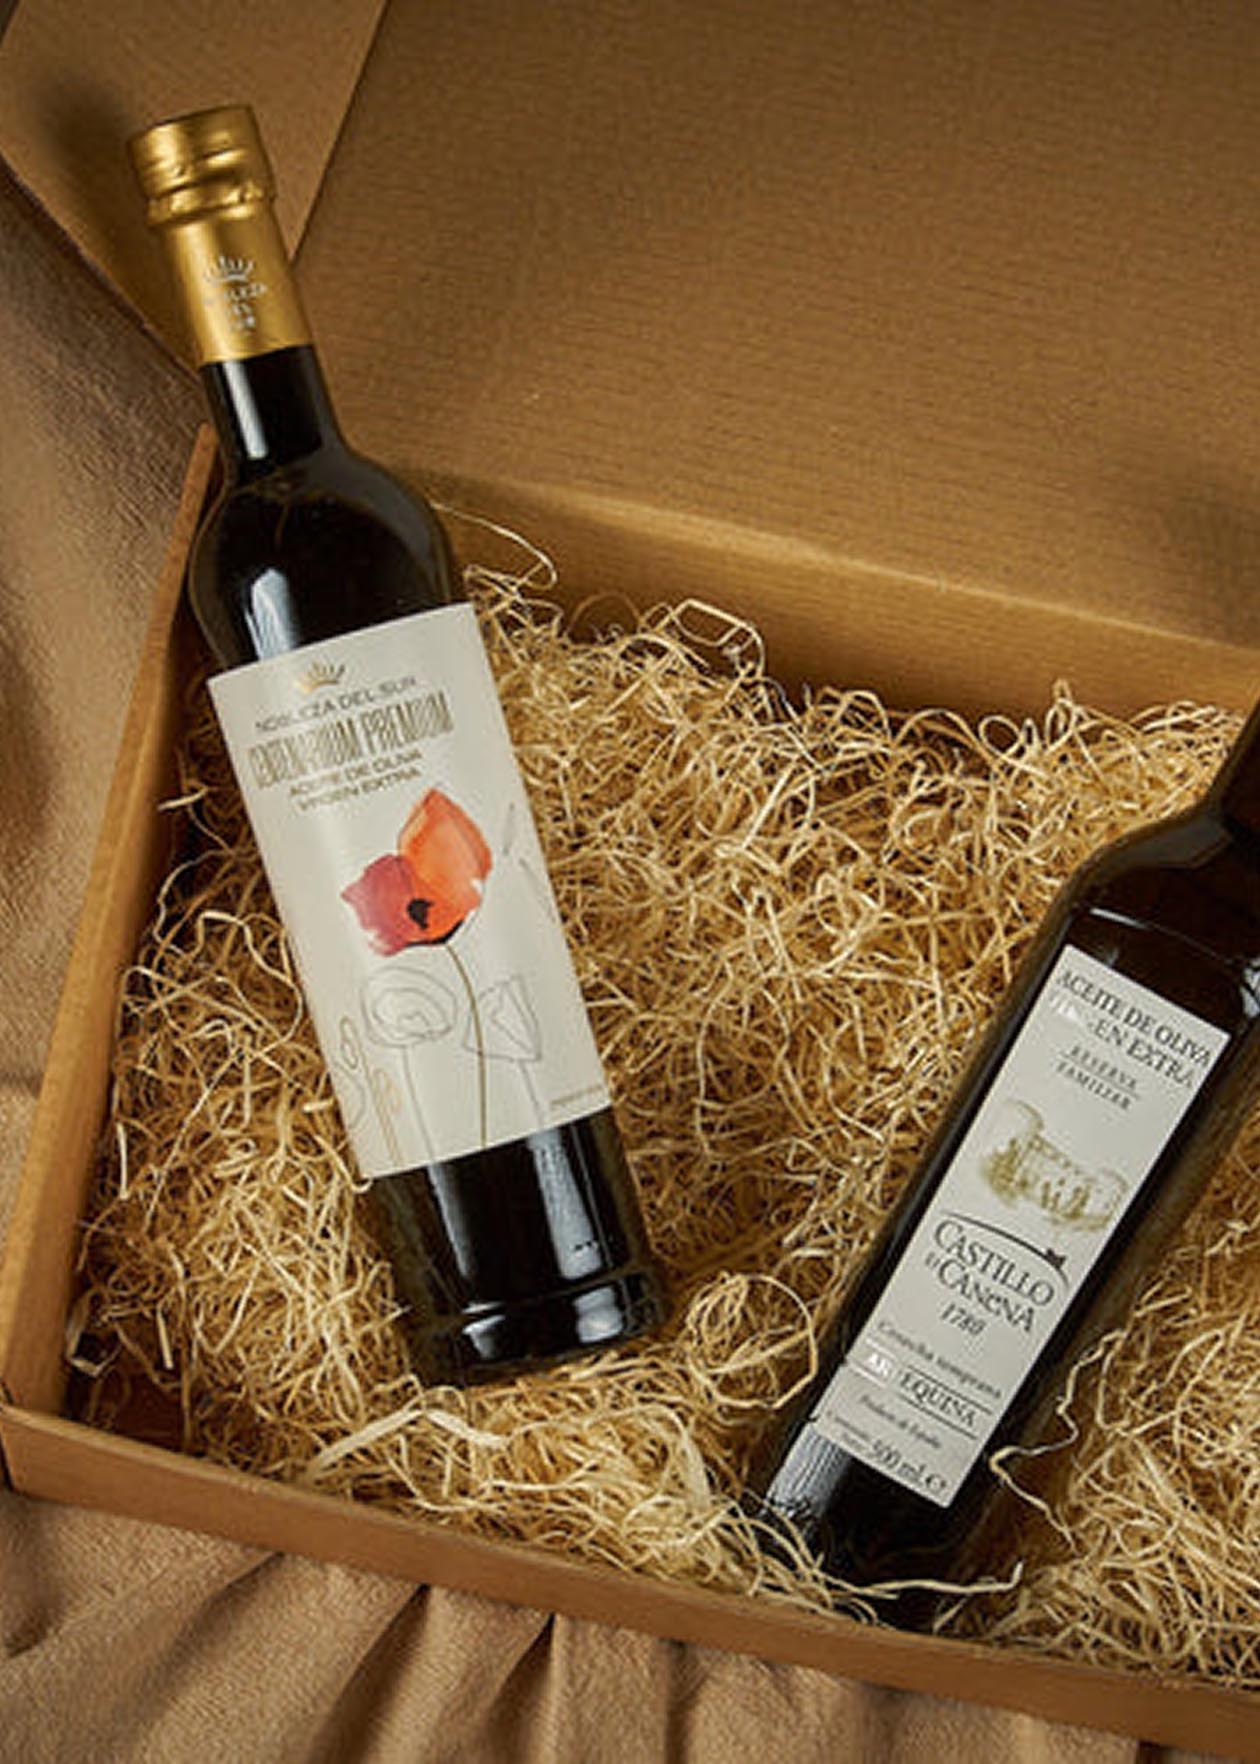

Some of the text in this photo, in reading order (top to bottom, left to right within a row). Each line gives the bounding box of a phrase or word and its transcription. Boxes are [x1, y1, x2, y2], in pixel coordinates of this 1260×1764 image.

[340, 689, 376, 711] DEL
[1056, 970, 1212, 1067] ACEITE DE OLIVA
[1126, 1037, 1195, 1088] EXTRA
[934, 1219, 1056, 1306] CASTILLO
